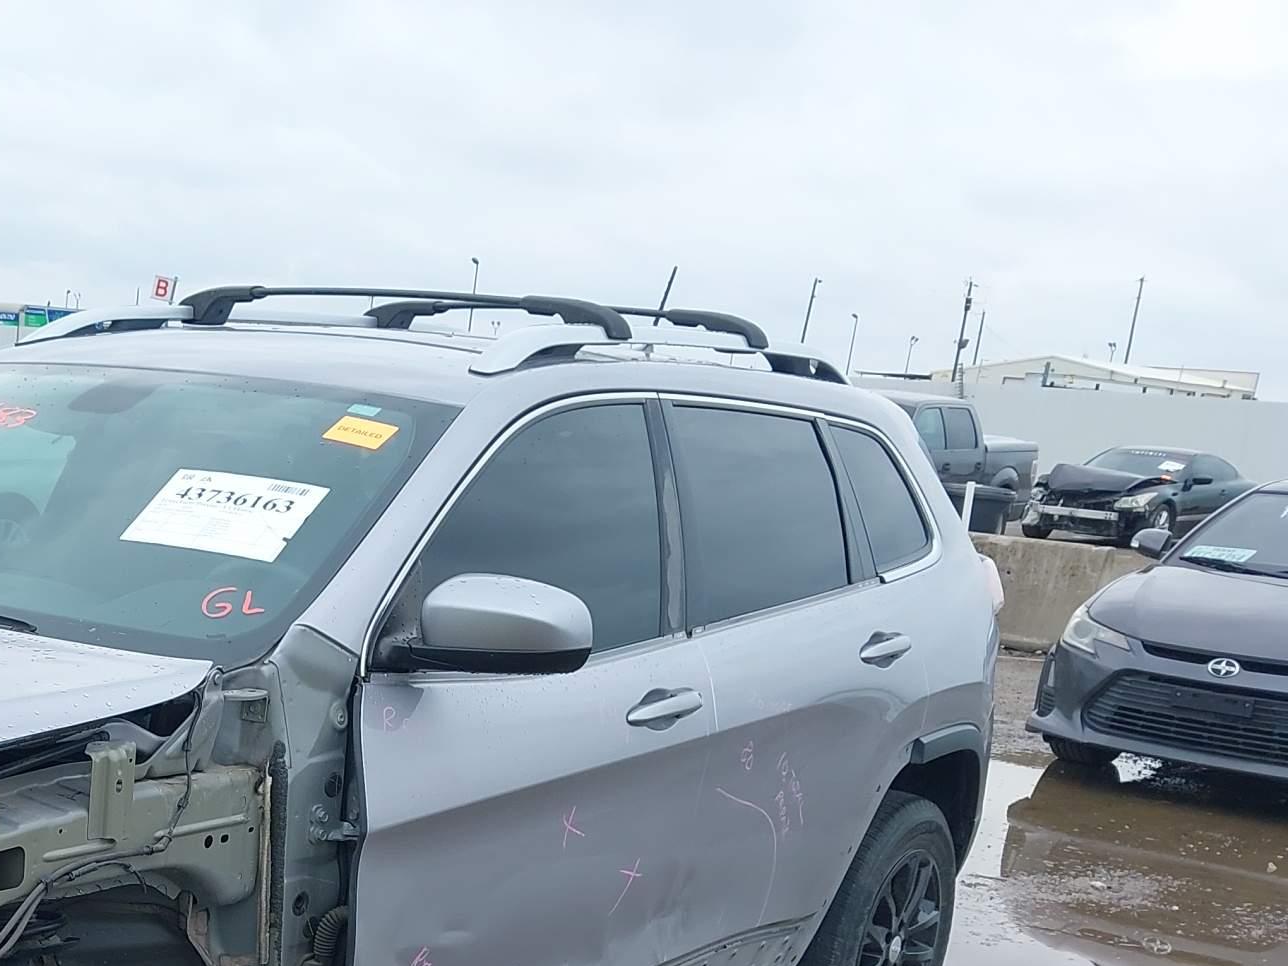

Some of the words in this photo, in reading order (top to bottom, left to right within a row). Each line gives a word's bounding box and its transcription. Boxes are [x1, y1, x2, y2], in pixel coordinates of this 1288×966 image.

[155, 278, 169, 298] B
[337, 425, 383, 440] DETAILED
[175, 486, 296, 514] 43736163
